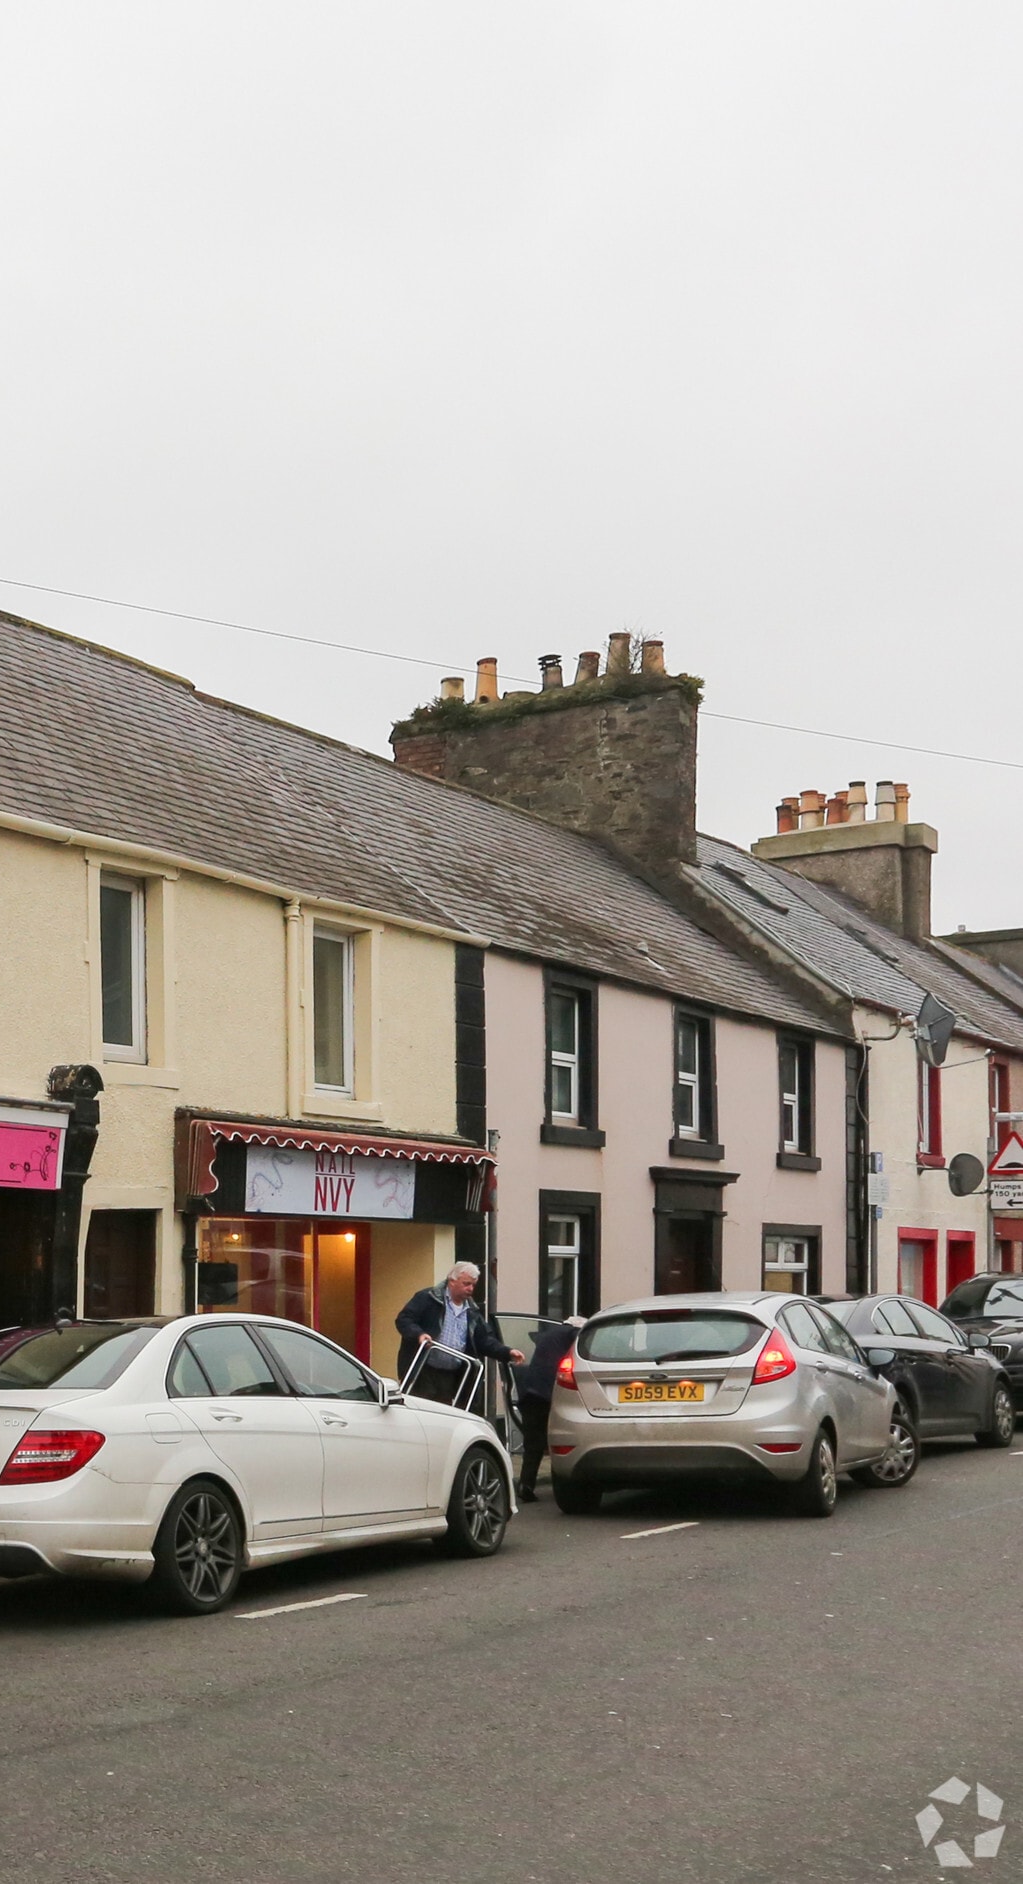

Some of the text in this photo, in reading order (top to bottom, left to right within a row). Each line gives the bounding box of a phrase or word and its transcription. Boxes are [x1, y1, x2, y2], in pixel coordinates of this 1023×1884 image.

[315, 1152, 355, 1175] NAIL
[314, 1175, 356, 1213] NVY
[624, 1385, 697, 1400] SD59 EVX
[4, 1419, 26, 1427] CDI
